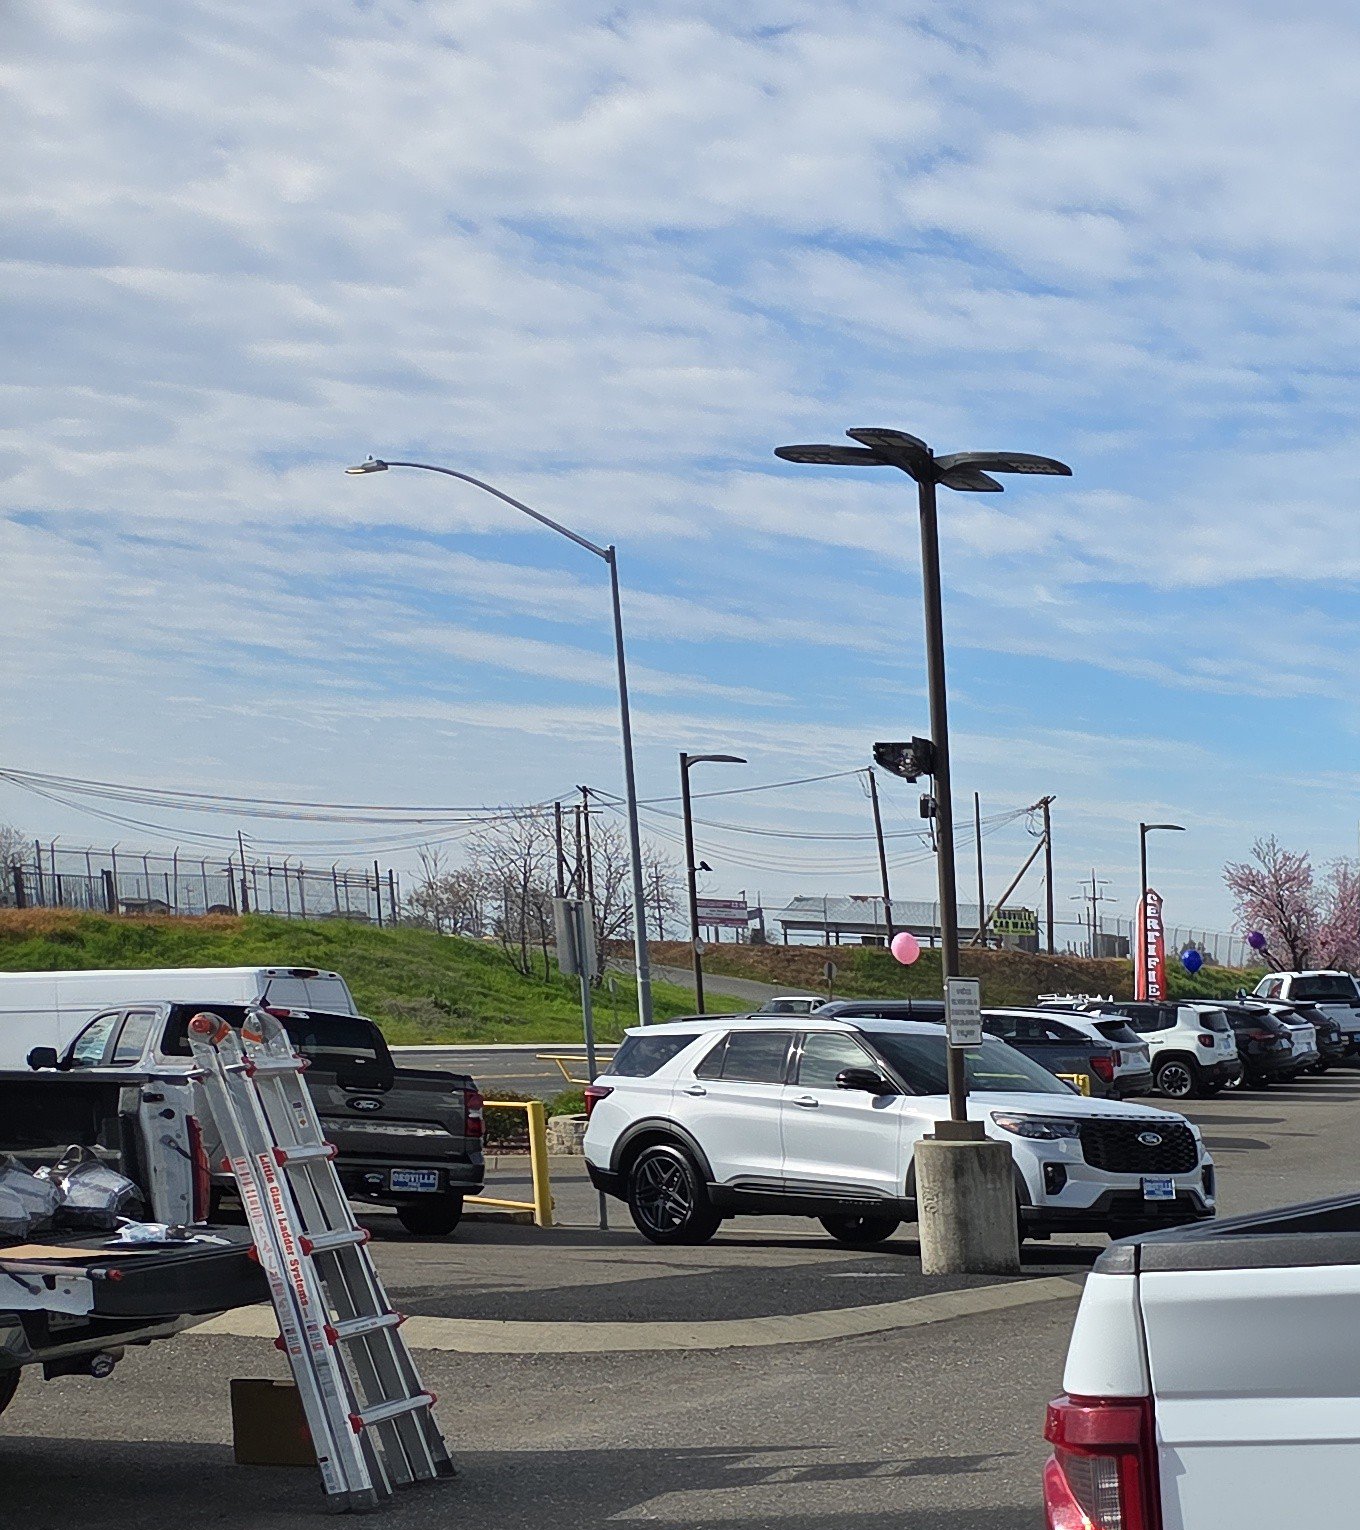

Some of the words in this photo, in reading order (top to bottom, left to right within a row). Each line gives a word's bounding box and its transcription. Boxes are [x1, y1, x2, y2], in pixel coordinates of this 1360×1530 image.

[1146, 893, 1161, 1001] CERTIFIE
[259, 1153, 275, 1184] Little
[270, 1186, 285, 1215] Giant
[278, 1217, 295, 1256] Ladder
[289, 1258, 309, 1307] Systems
